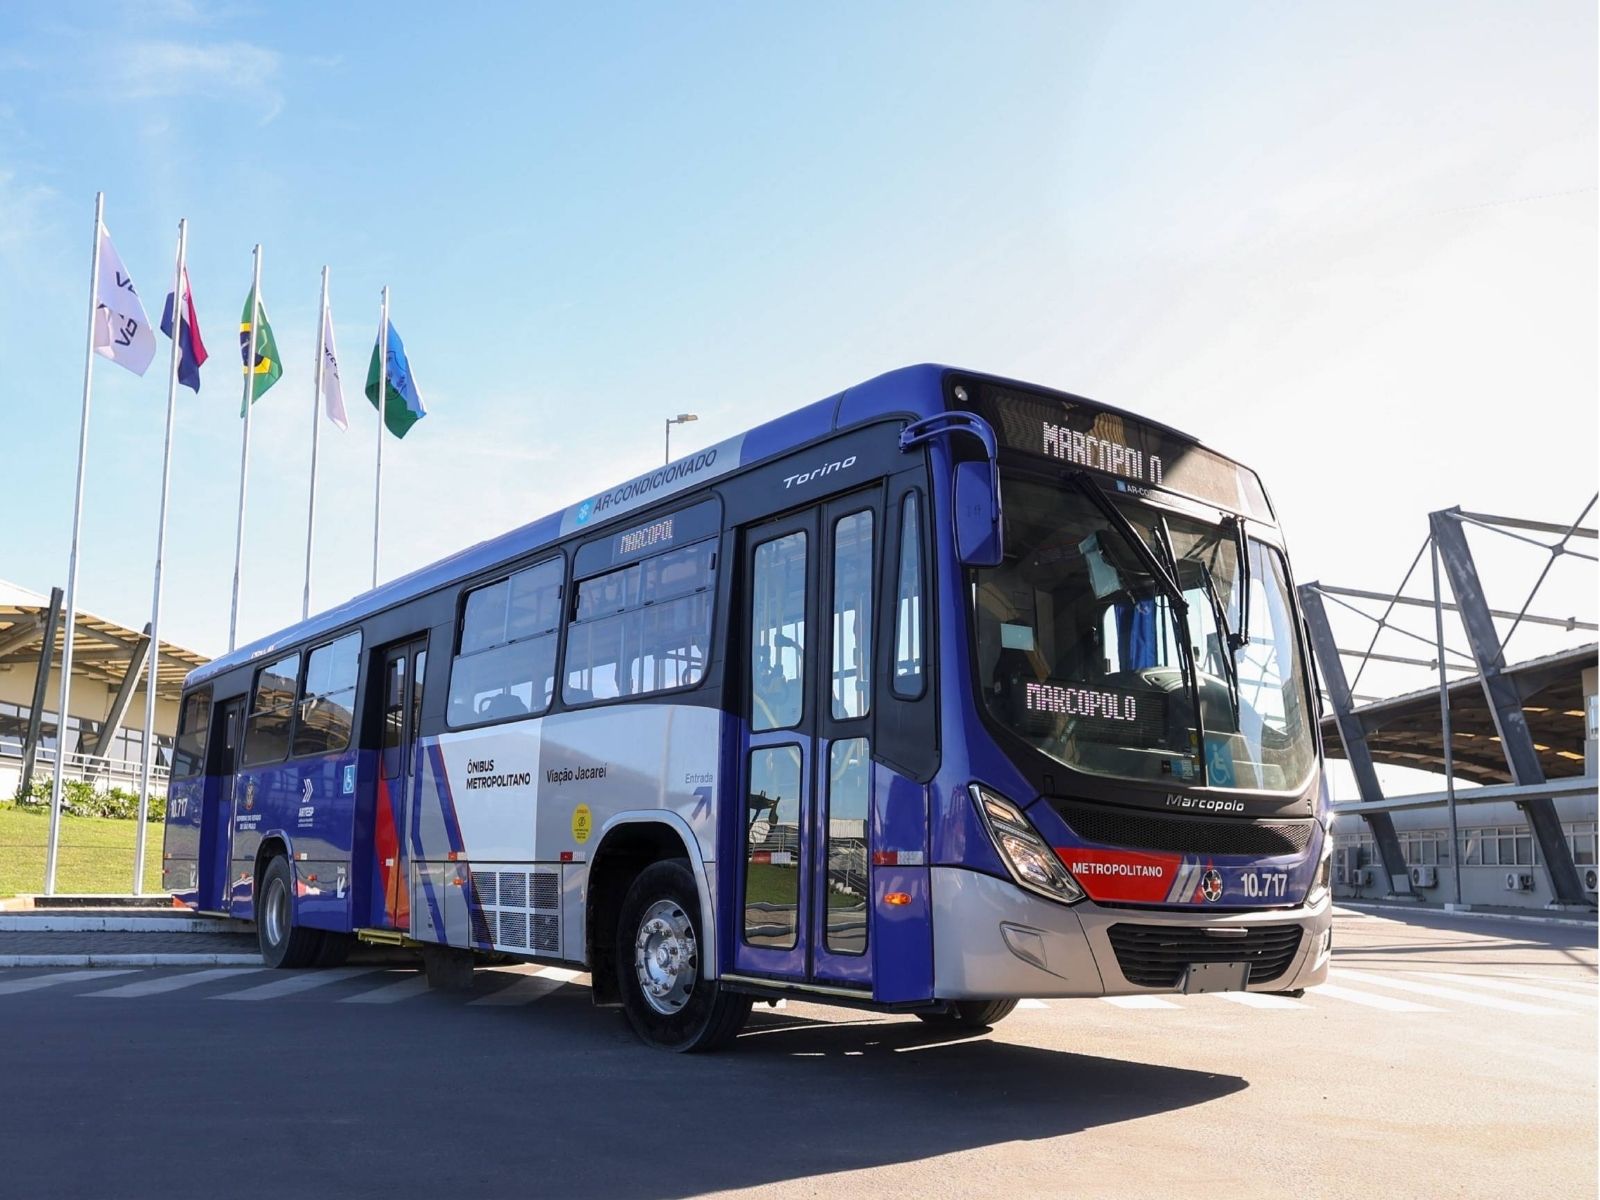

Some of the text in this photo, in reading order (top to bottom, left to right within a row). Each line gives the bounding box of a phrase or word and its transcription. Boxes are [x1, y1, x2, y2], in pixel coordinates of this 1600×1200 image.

[593, 449, 717, 514] AR-CONDICIONADO
[783, 456, 857, 489] Torino
[1027, 683, 1136, 721] MARCOPOLO
[467, 759, 495, 774] ÔNIBUS
[546, 763, 607, 786] Viação Jacareí
[466, 772, 531, 789] METROPOLITANO
[685, 772, 714, 784] Entrada
[1166, 793, 1245, 812] Marcopolo
[1072, 862, 1163, 877] METROPOLITANO
[1241, 873, 1288, 897] 10.717
